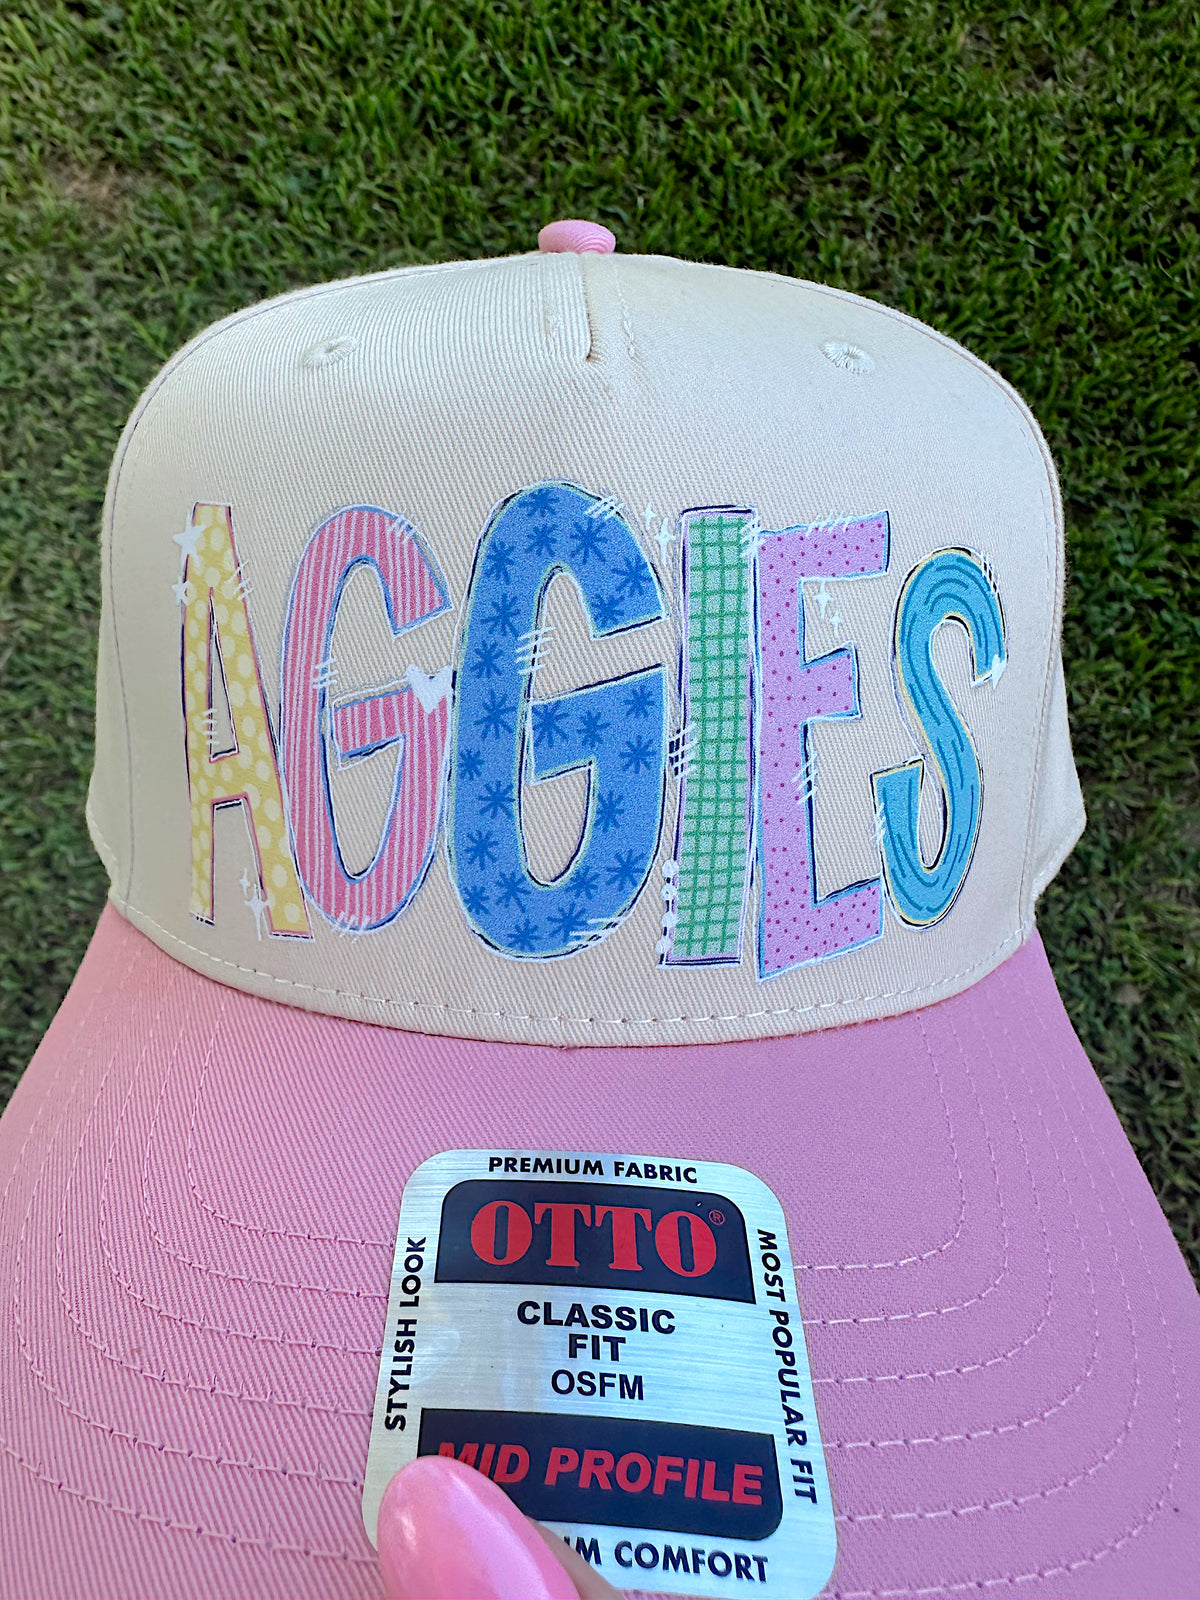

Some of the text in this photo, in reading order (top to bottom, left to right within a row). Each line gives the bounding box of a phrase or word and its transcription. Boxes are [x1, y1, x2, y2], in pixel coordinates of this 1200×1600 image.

[180, 479, 1008, 983] AGGIES
[489, 1156, 698, 1184] PREMIUM FABRIC
[385, 1236, 426, 1431] STYLISH LOOK
[516, 1301, 676, 1334] CLASSIC
[568, 1334, 626, 1362] FIT
[757, 1229, 817, 1504] MOST POPULAR FIT
[551, 1369, 644, 1400] OSFM
[544, 1446, 763, 1506] PROFILE
[614, 1540, 768, 1583] COMFORT
